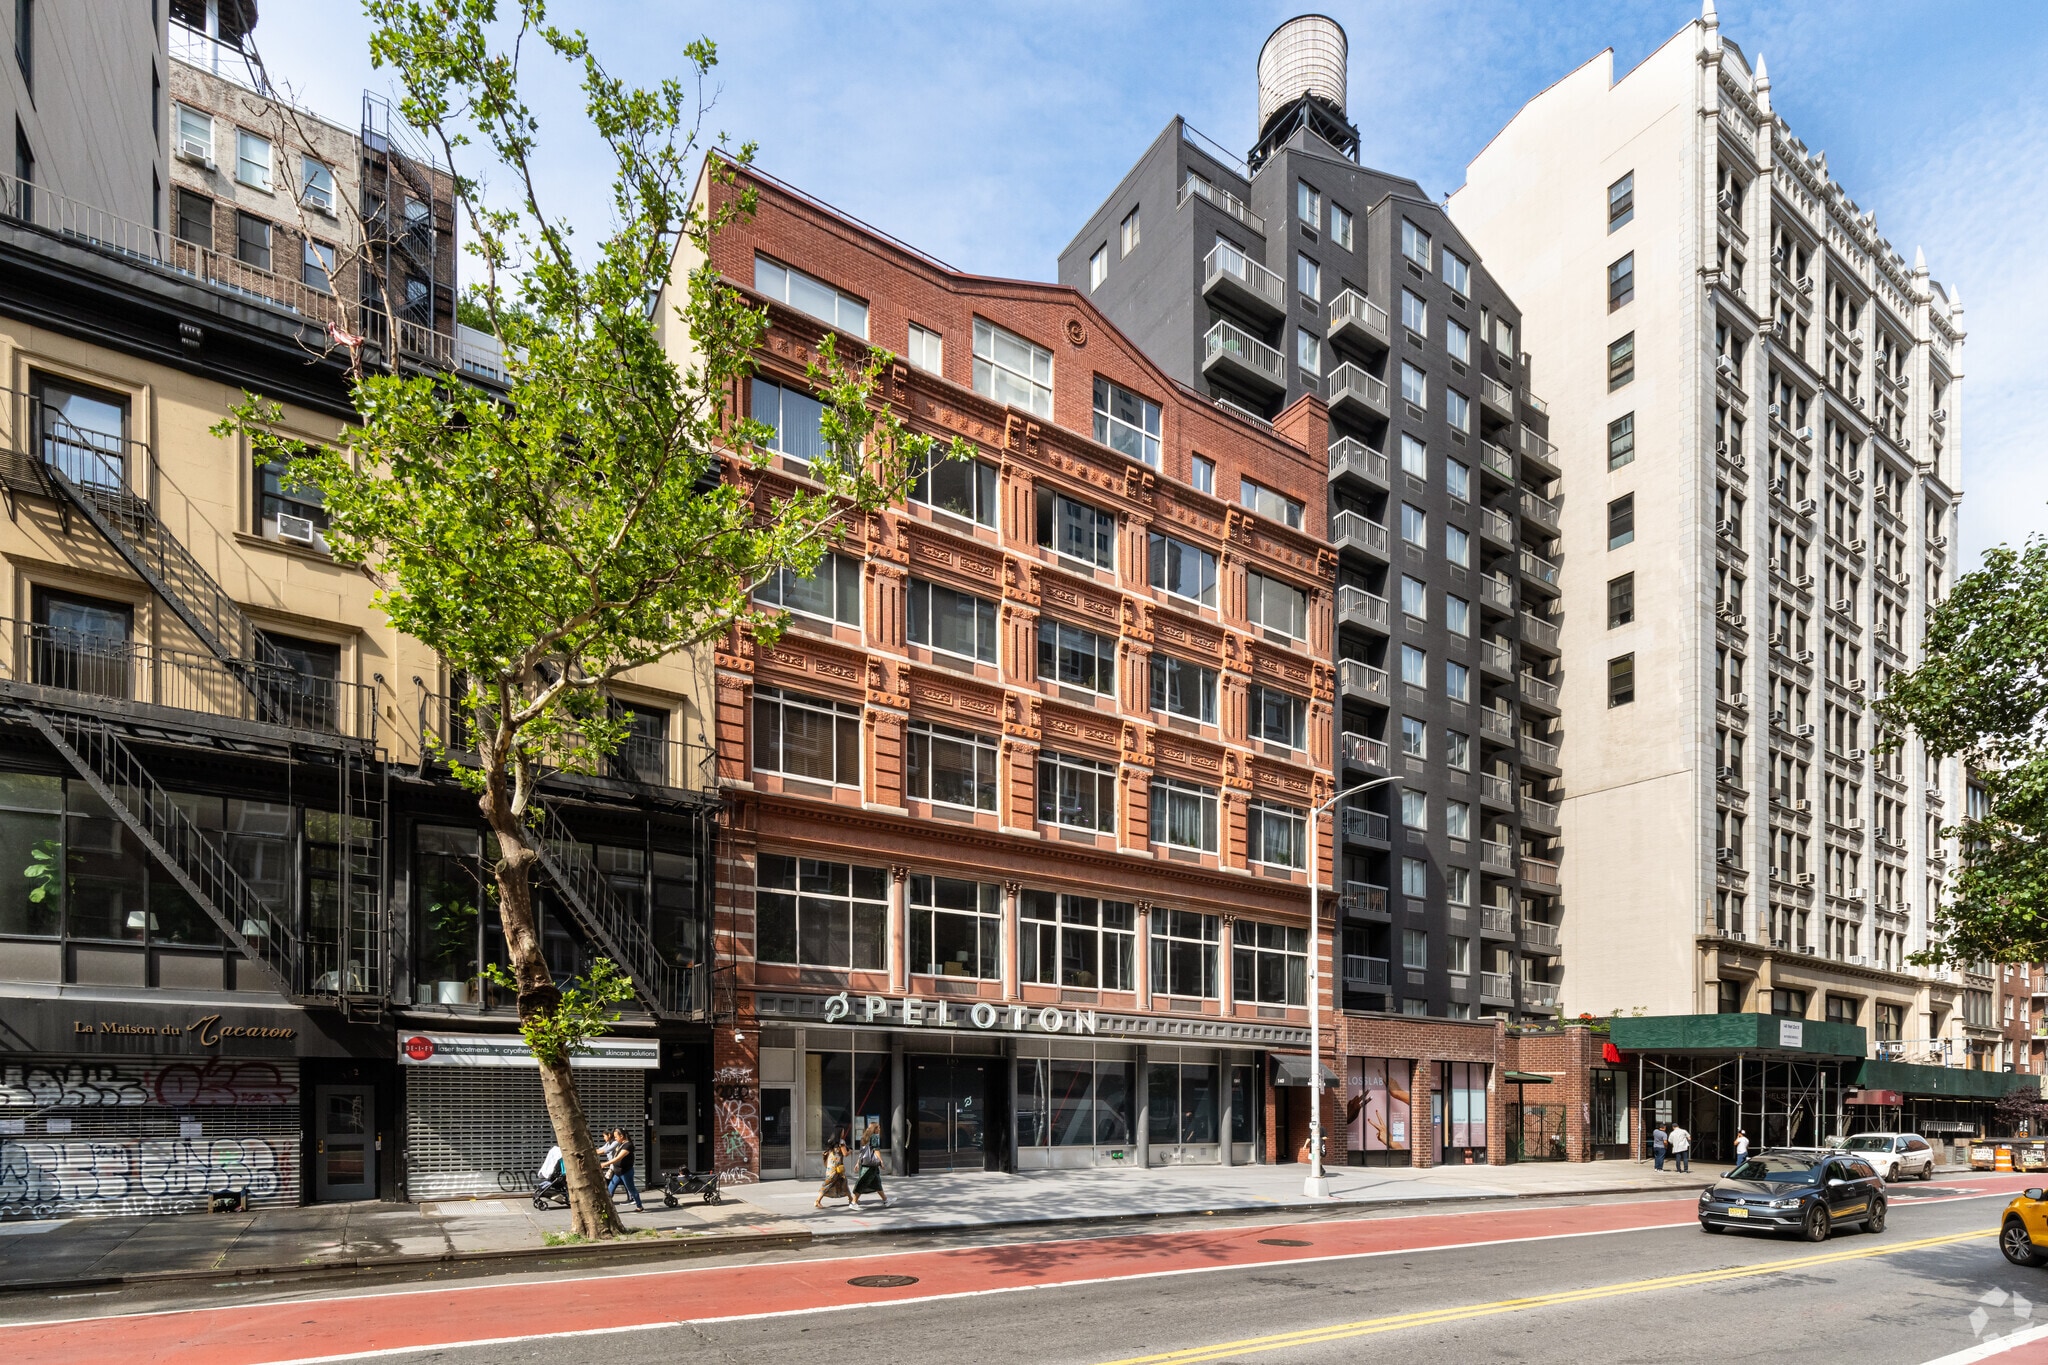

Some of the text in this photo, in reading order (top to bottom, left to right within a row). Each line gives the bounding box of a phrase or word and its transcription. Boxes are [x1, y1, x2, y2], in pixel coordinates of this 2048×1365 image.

[865, 994, 1096, 1035] PELOTON
[74, 1014, 295, 1046] La Maison du Macaron
[503, 1047, 534, 1055] cryothera
[1347, 1076, 1384, 1086] LOSSLAB
